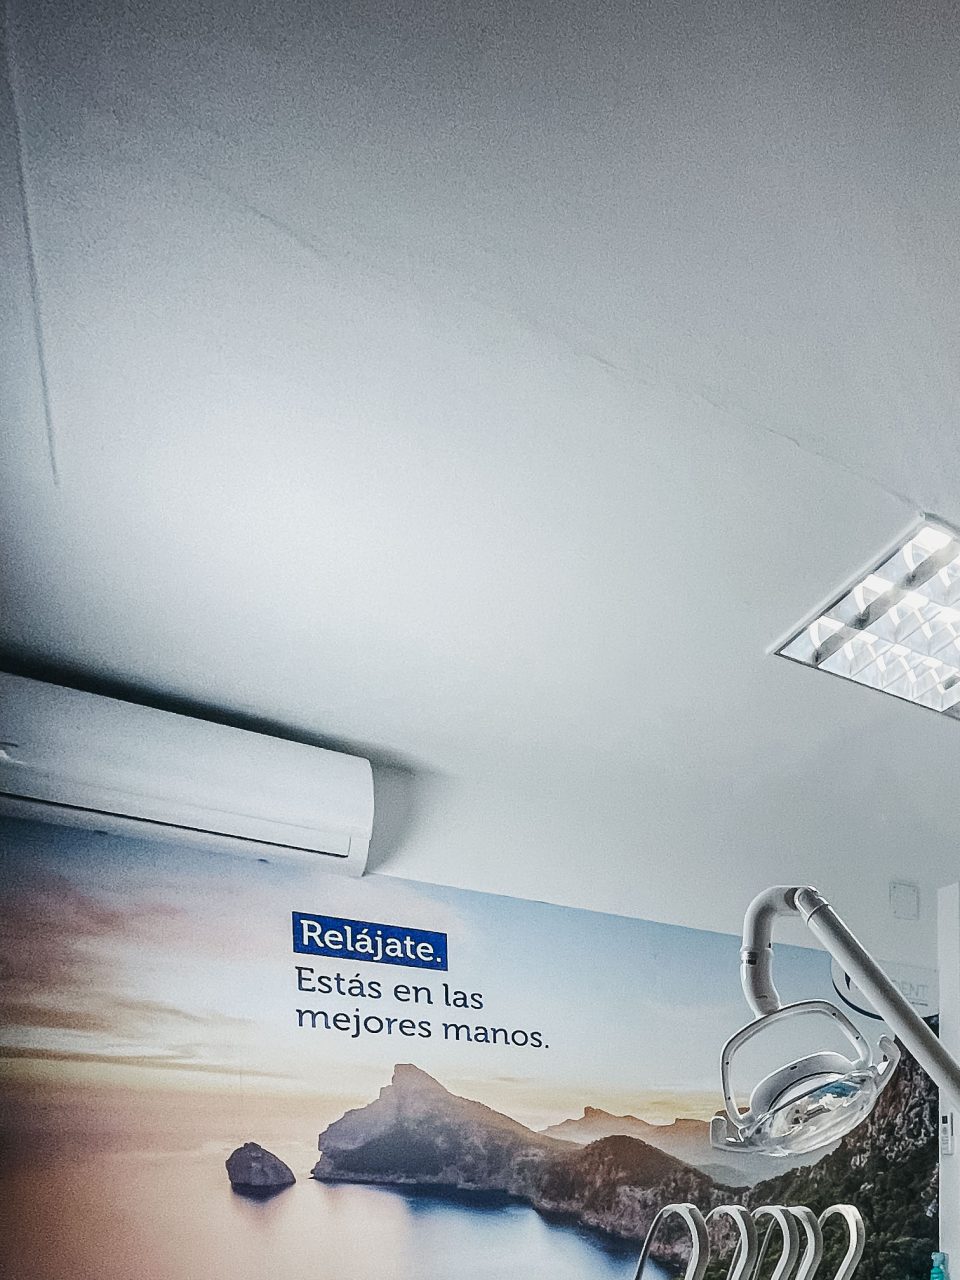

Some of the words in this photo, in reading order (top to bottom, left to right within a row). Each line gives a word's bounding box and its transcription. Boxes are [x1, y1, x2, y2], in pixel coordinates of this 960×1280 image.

[300, 919, 442, 962] Relájate.
[295, 966, 382, 999] Estás
[393, 984, 433, 1005] en
[442, 983, 484, 1010] las
[296, 1008, 432, 1038] mejores
[442, 1022, 550, 1049] manos.
